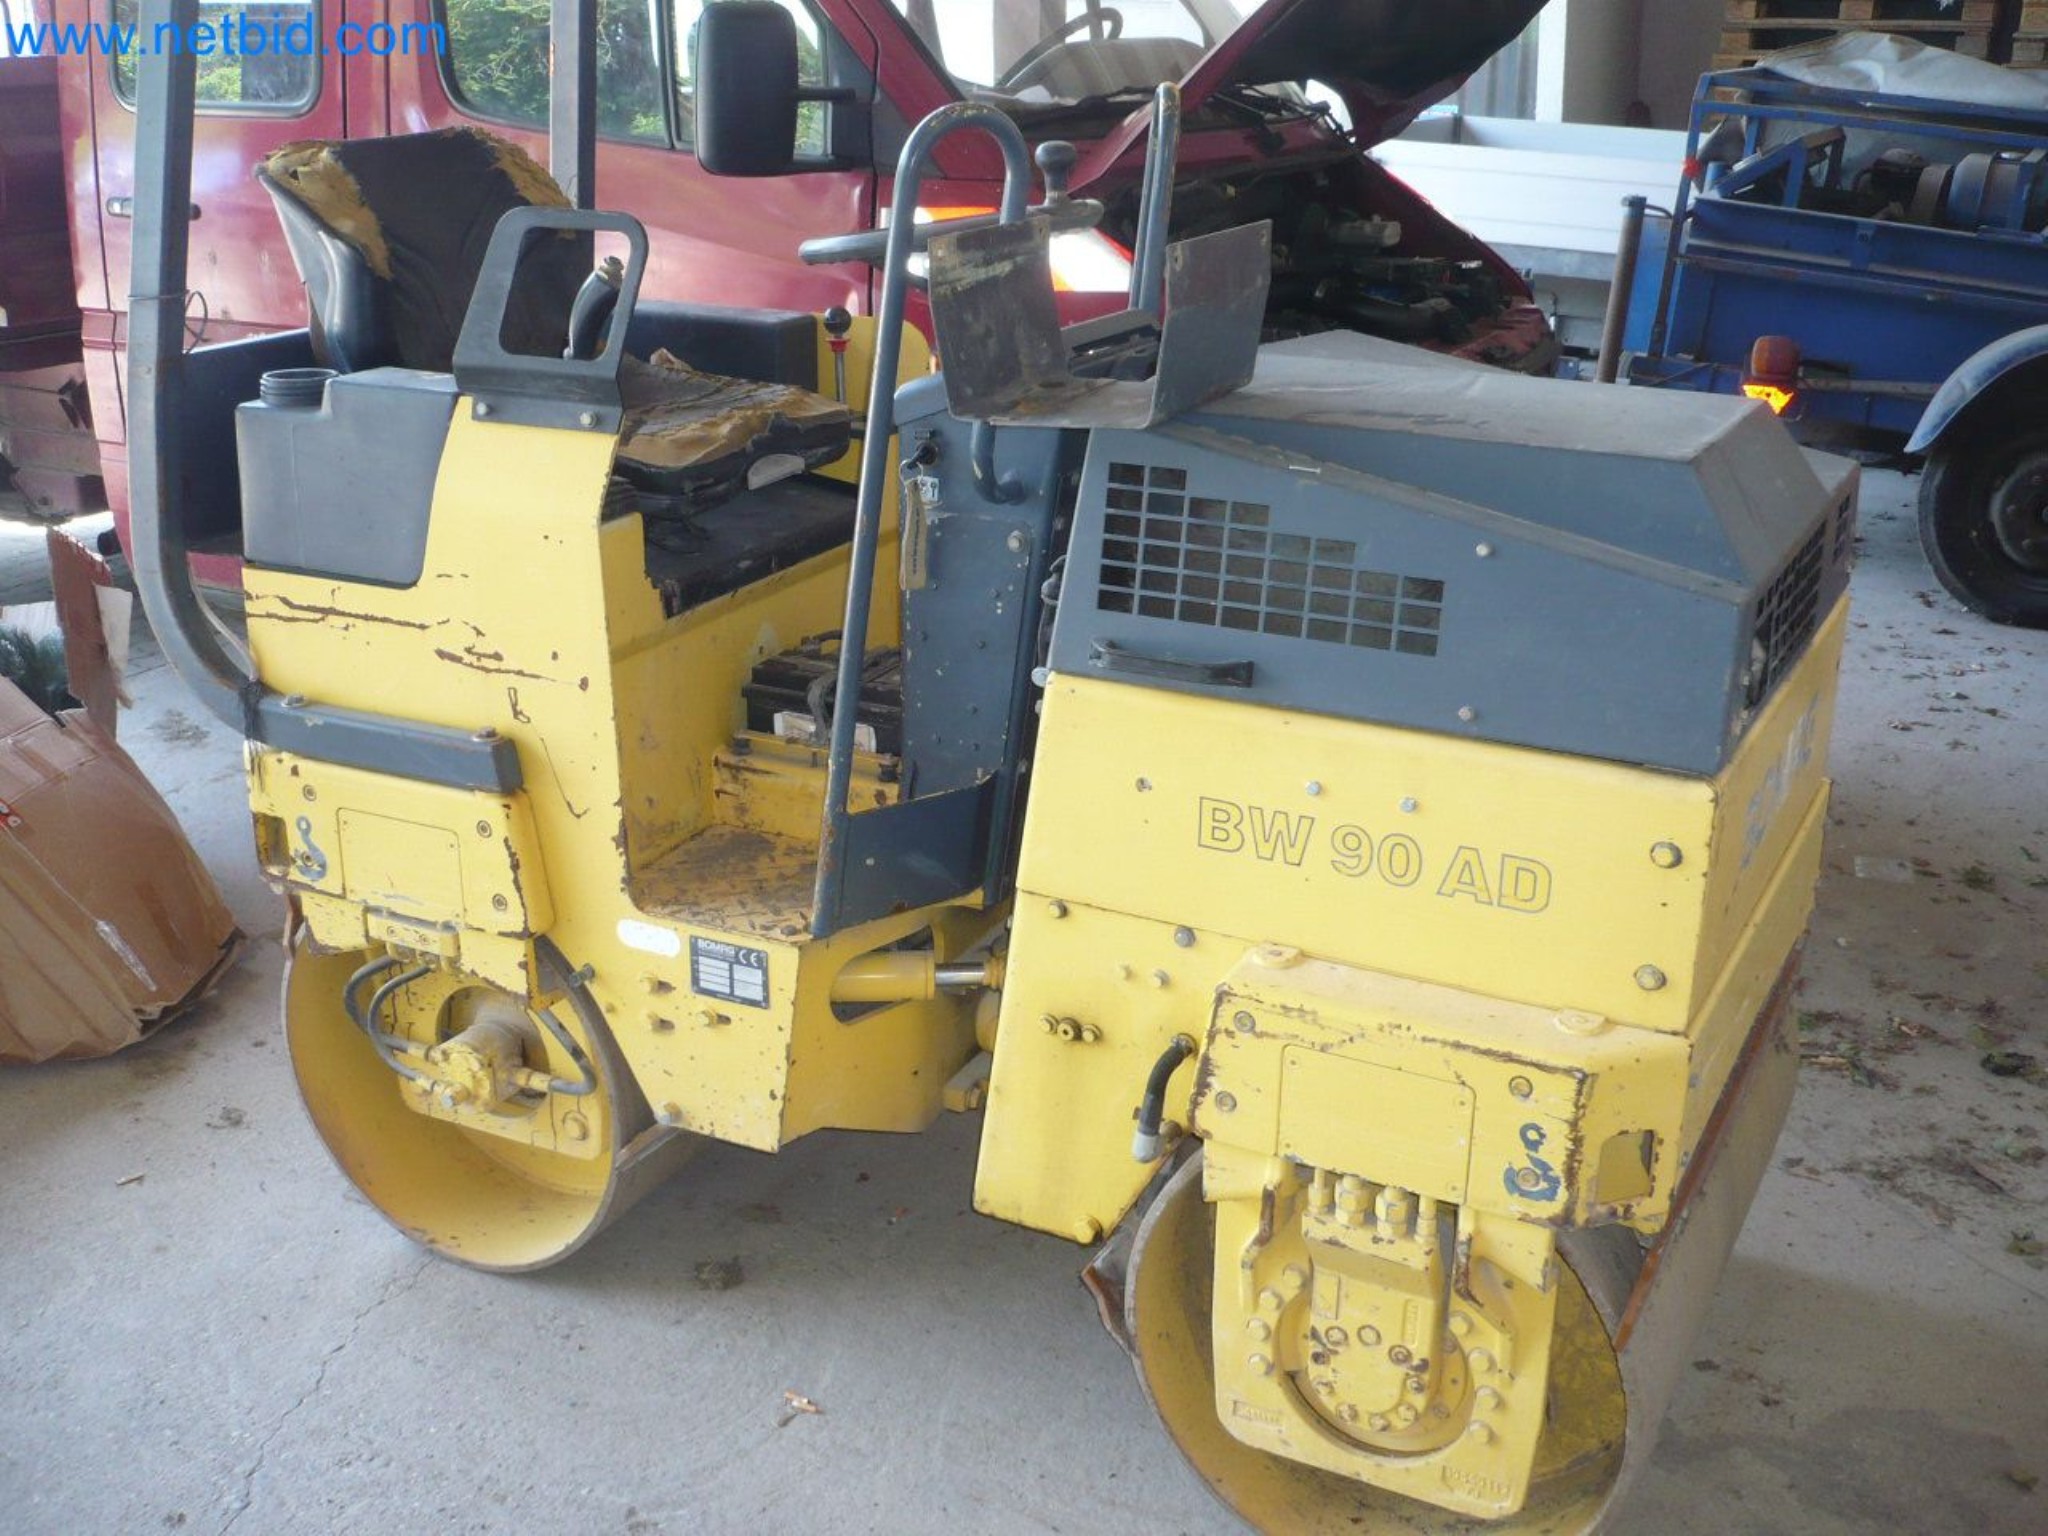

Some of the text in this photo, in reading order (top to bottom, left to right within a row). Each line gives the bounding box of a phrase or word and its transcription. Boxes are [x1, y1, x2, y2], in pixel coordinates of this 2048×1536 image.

[1197, 795, 1553, 915] BW 90 AD
